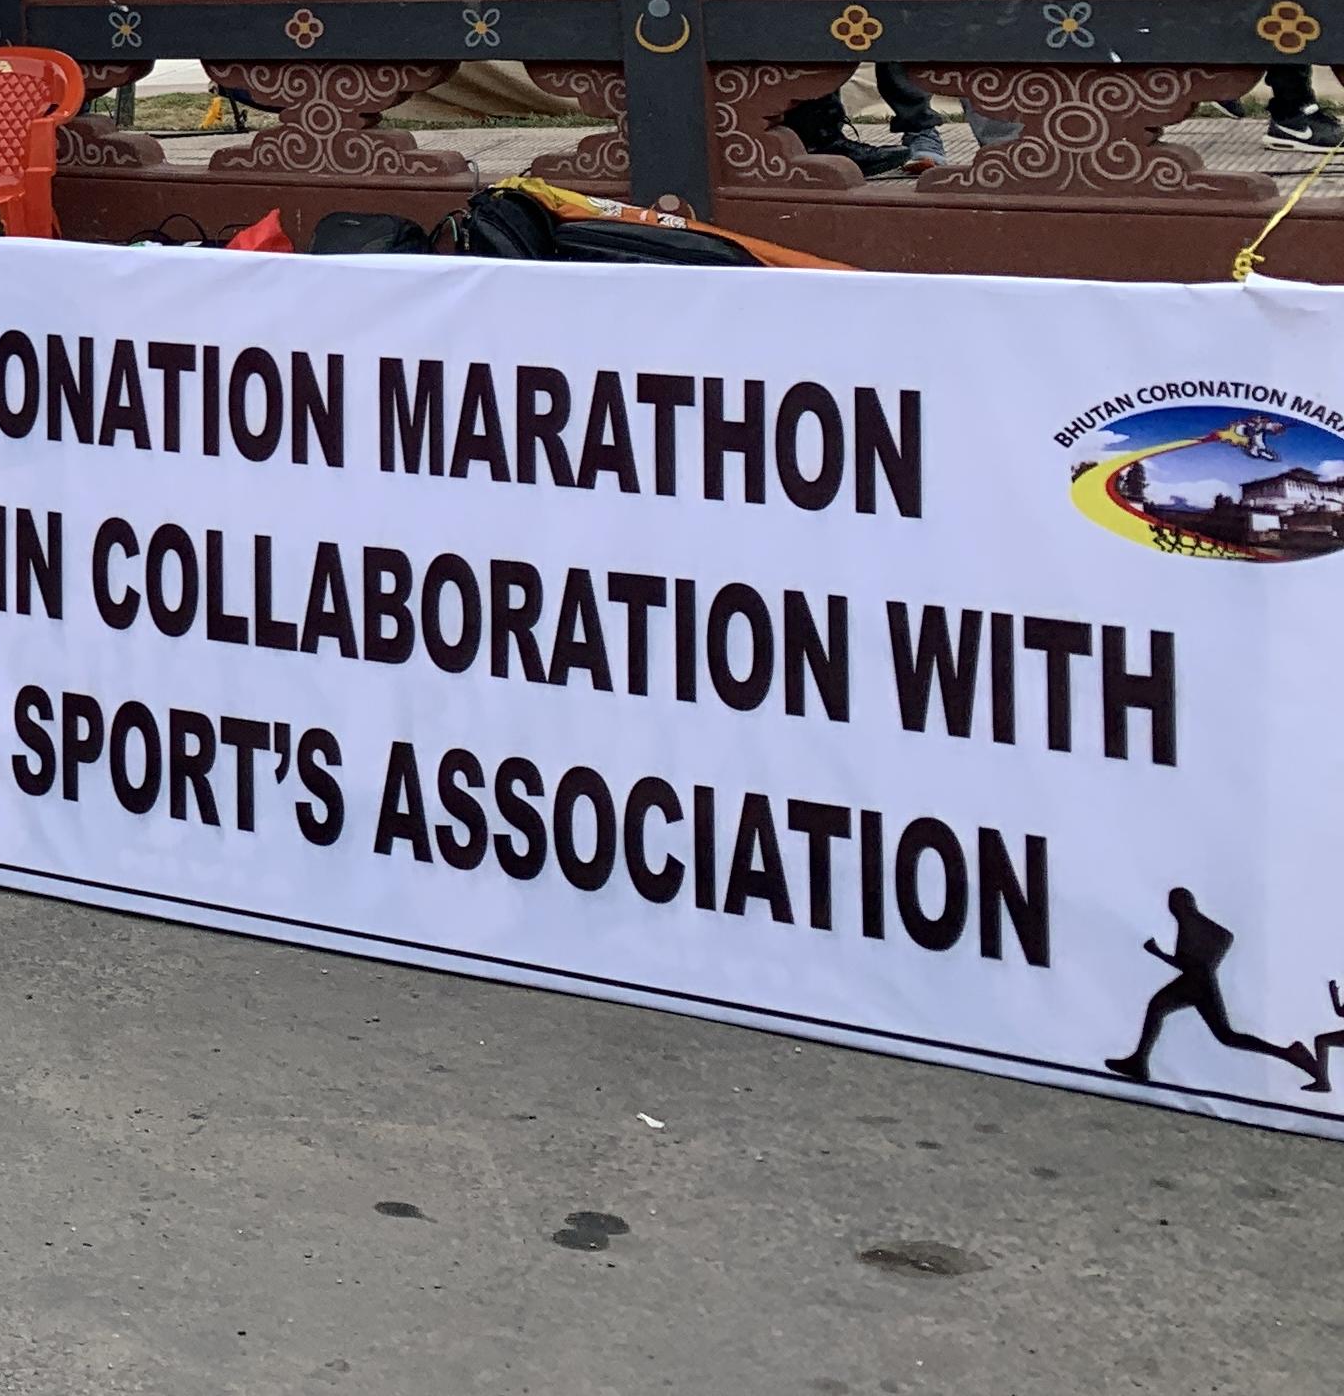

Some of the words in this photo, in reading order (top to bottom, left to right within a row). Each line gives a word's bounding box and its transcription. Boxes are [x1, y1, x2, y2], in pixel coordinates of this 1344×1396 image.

[378, 355, 923, 519] MARATHON
[1053, 393, 1136, 449] BHUTAN
[1136, 380, 1288, 407] CORONATION
[92, 516, 851, 723] COLLABORATION
[885, 599, 1178, 767] WITH
[12, 684, 345, 847] SPORT'S
[373, 740, 1051, 969] ASSOCIATION
